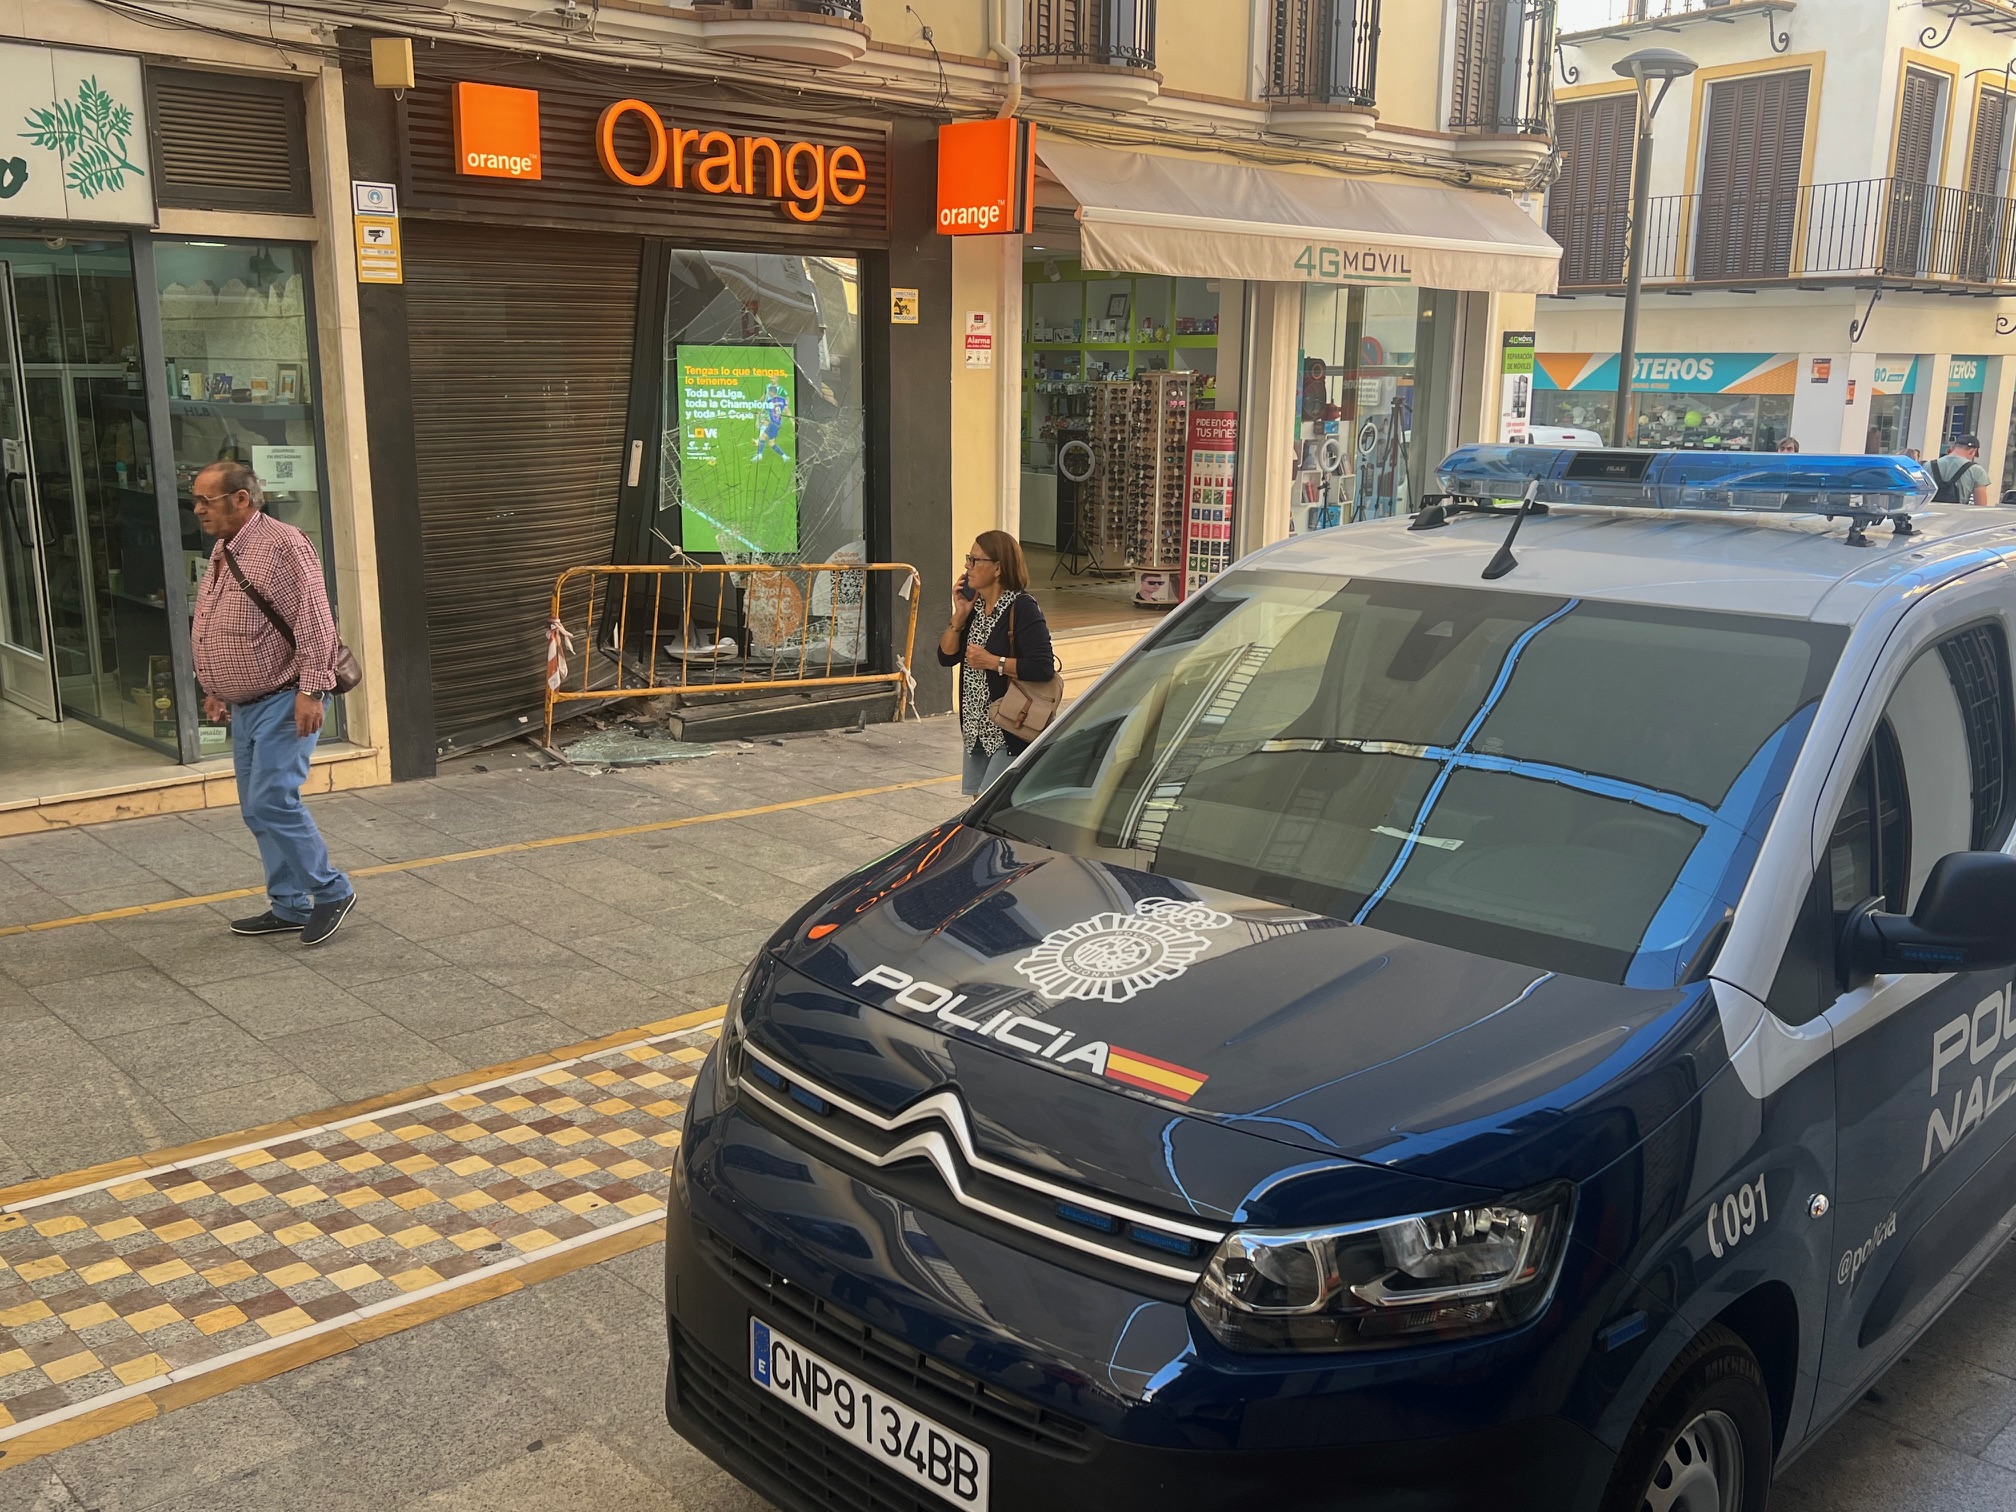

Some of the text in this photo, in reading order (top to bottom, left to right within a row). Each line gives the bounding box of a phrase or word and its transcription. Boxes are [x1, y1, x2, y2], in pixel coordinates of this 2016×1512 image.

[598, 98, 867, 222] Orange
[967, 336, 991, 345] Alarma
[1507, 352, 1533, 361] REPARACIÓN
[684, 365, 788, 378] Tengas lo que tengas,
[1513, 362, 1532, 370] MÓVILES
[685, 376, 739, 386] lo tenemos
[684, 388, 746, 400] Toda LaLiga,
[685, 399, 775, 410] toda la Champions
[685, 410, 692, 419] y
[693, 409, 716, 418] toda
[728, 409, 755, 420] Copa
[1196, 418, 1211, 427] PIDE
[1196, 427, 1237, 438] TUS PINES
[1063, 956, 1121, 977] NACIONAL
[1921, 1047, 2016, 1175] NAC
[1722, 1172, 1769, 1247] 091
[758, 1358, 766, 1376] E
[1704, 1354, 1762, 1387] MICHELIN
[771, 1340, 979, 1502] CNP9134BB
